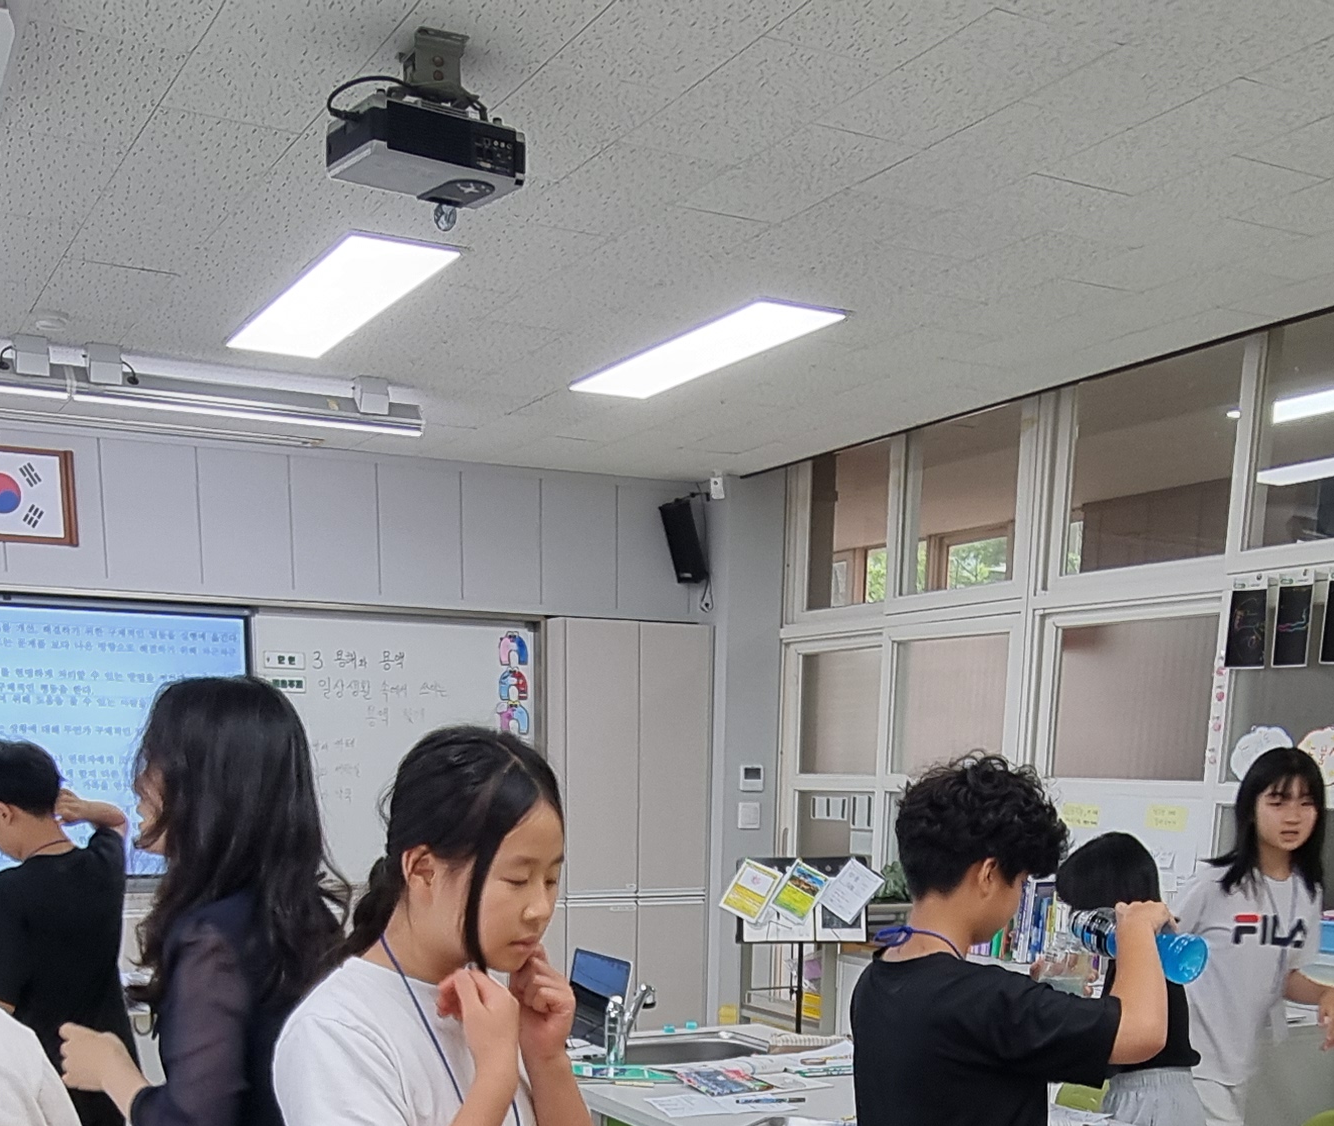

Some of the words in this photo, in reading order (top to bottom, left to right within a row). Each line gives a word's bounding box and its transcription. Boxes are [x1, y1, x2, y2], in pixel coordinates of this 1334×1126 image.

[312, 650, 324, 670] 3
[378, 650, 405, 671] 용액
[318, 676, 372, 701] 일상생활
[1232, 914, 1308, 949] FILA
